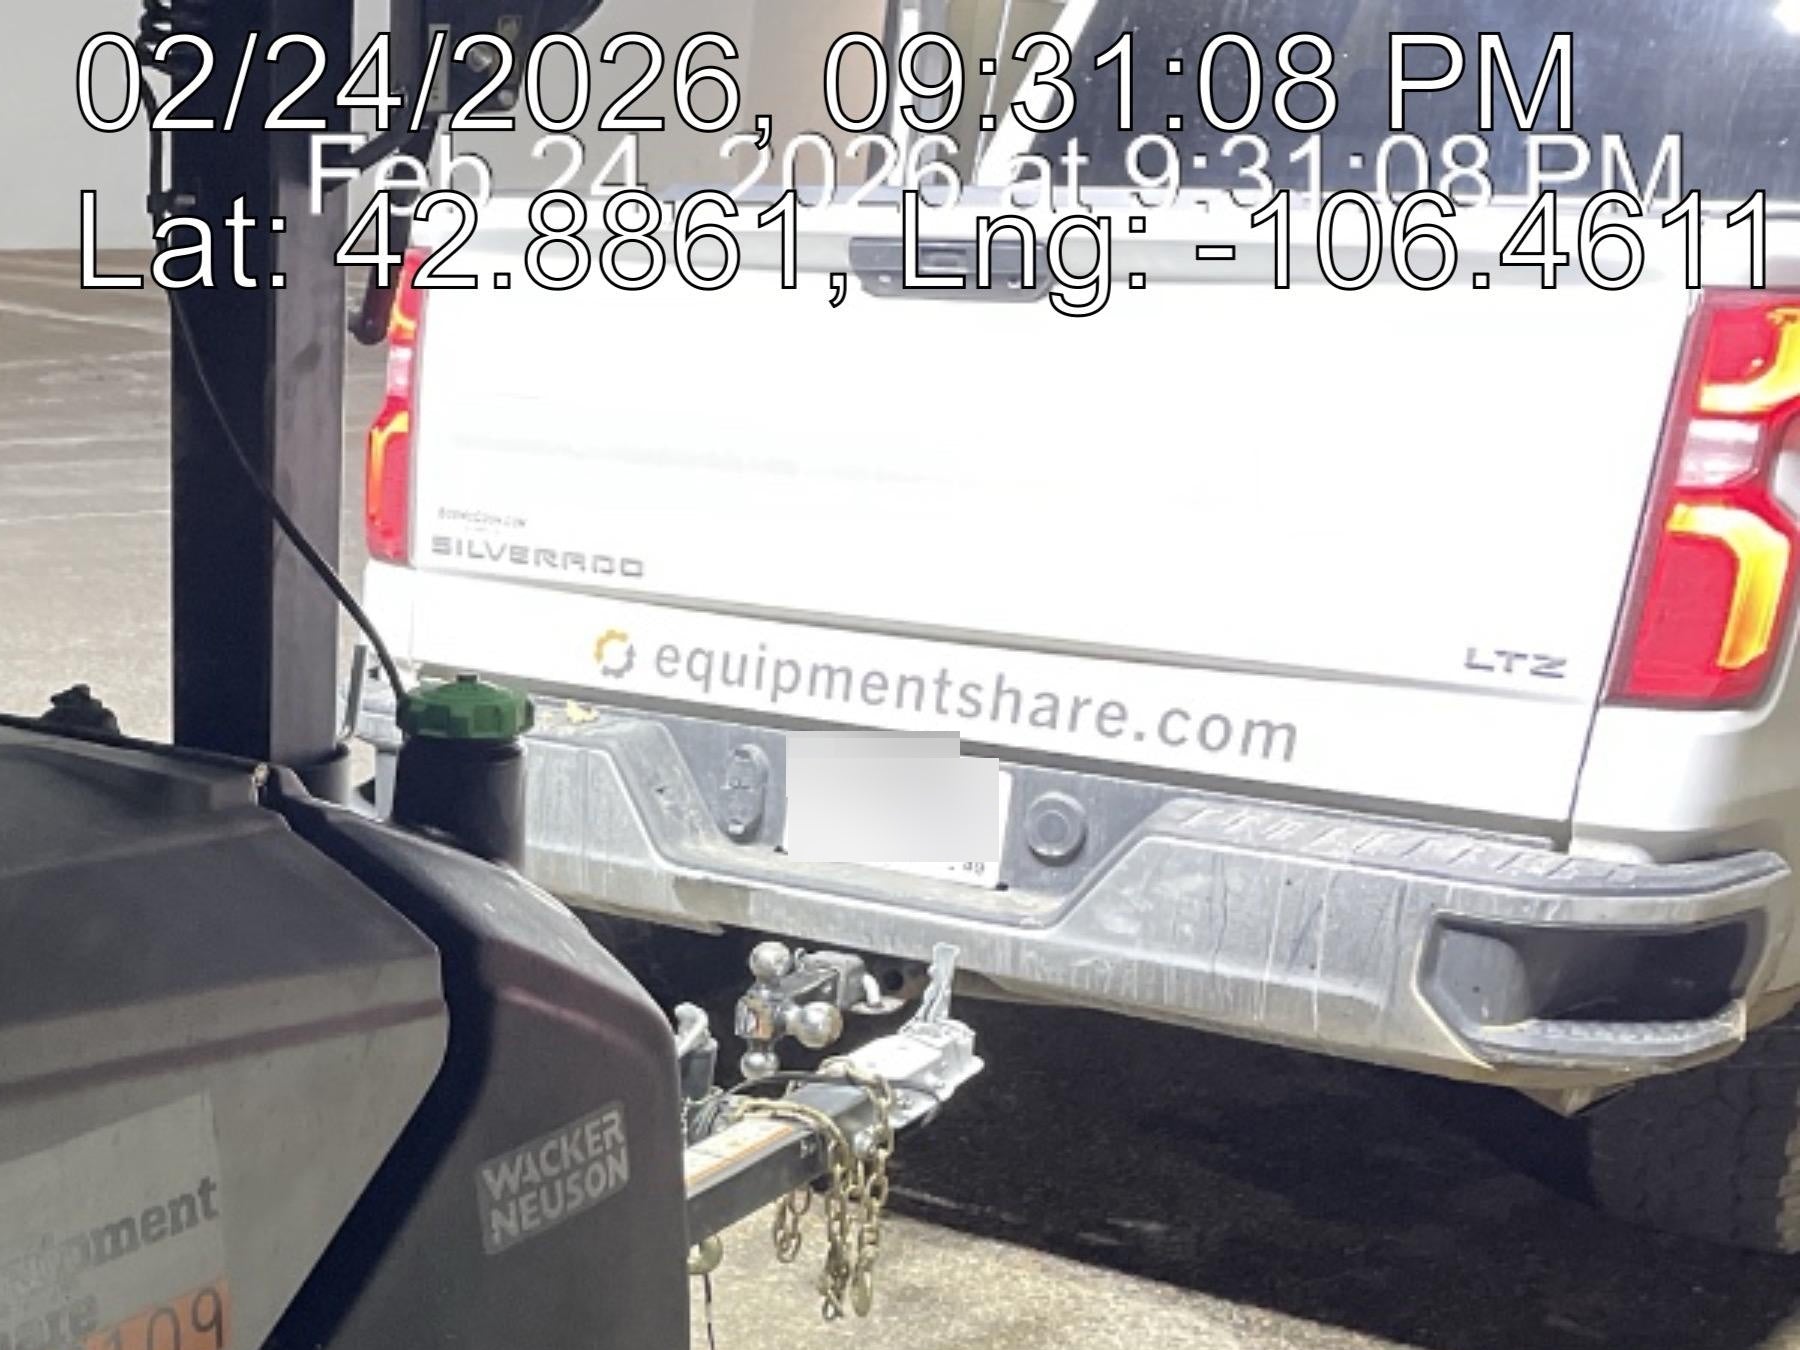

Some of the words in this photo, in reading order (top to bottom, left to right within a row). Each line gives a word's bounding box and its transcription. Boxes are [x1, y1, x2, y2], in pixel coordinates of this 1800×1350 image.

[431, 534, 644, 578] SILVERADO
[654, 641, 1299, 764] equipmentshare.com
[1464, 646, 1568, 679] LTZ
[481, 1109, 625, 1202] WACKER
[491, 1144, 630, 1244] NEUSON
